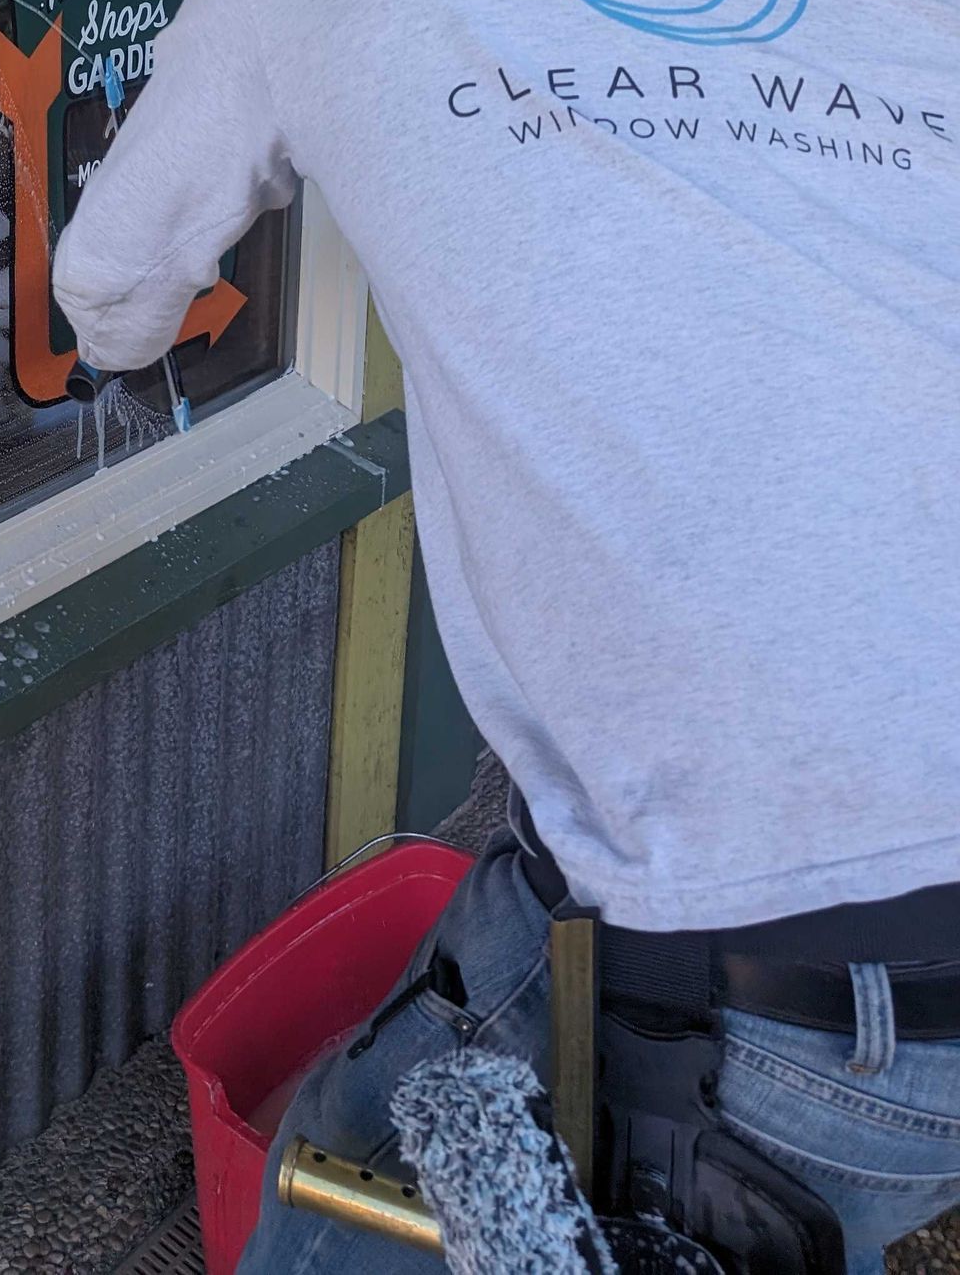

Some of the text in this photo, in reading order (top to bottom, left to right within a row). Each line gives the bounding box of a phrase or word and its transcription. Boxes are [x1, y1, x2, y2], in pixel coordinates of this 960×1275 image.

[77, 0, 169, 50] Shops
[68, 40, 156, 95] GARDE
[448, 65, 953, 142] CLEAR WAVE
[725, 118, 913, 170] WASHING
